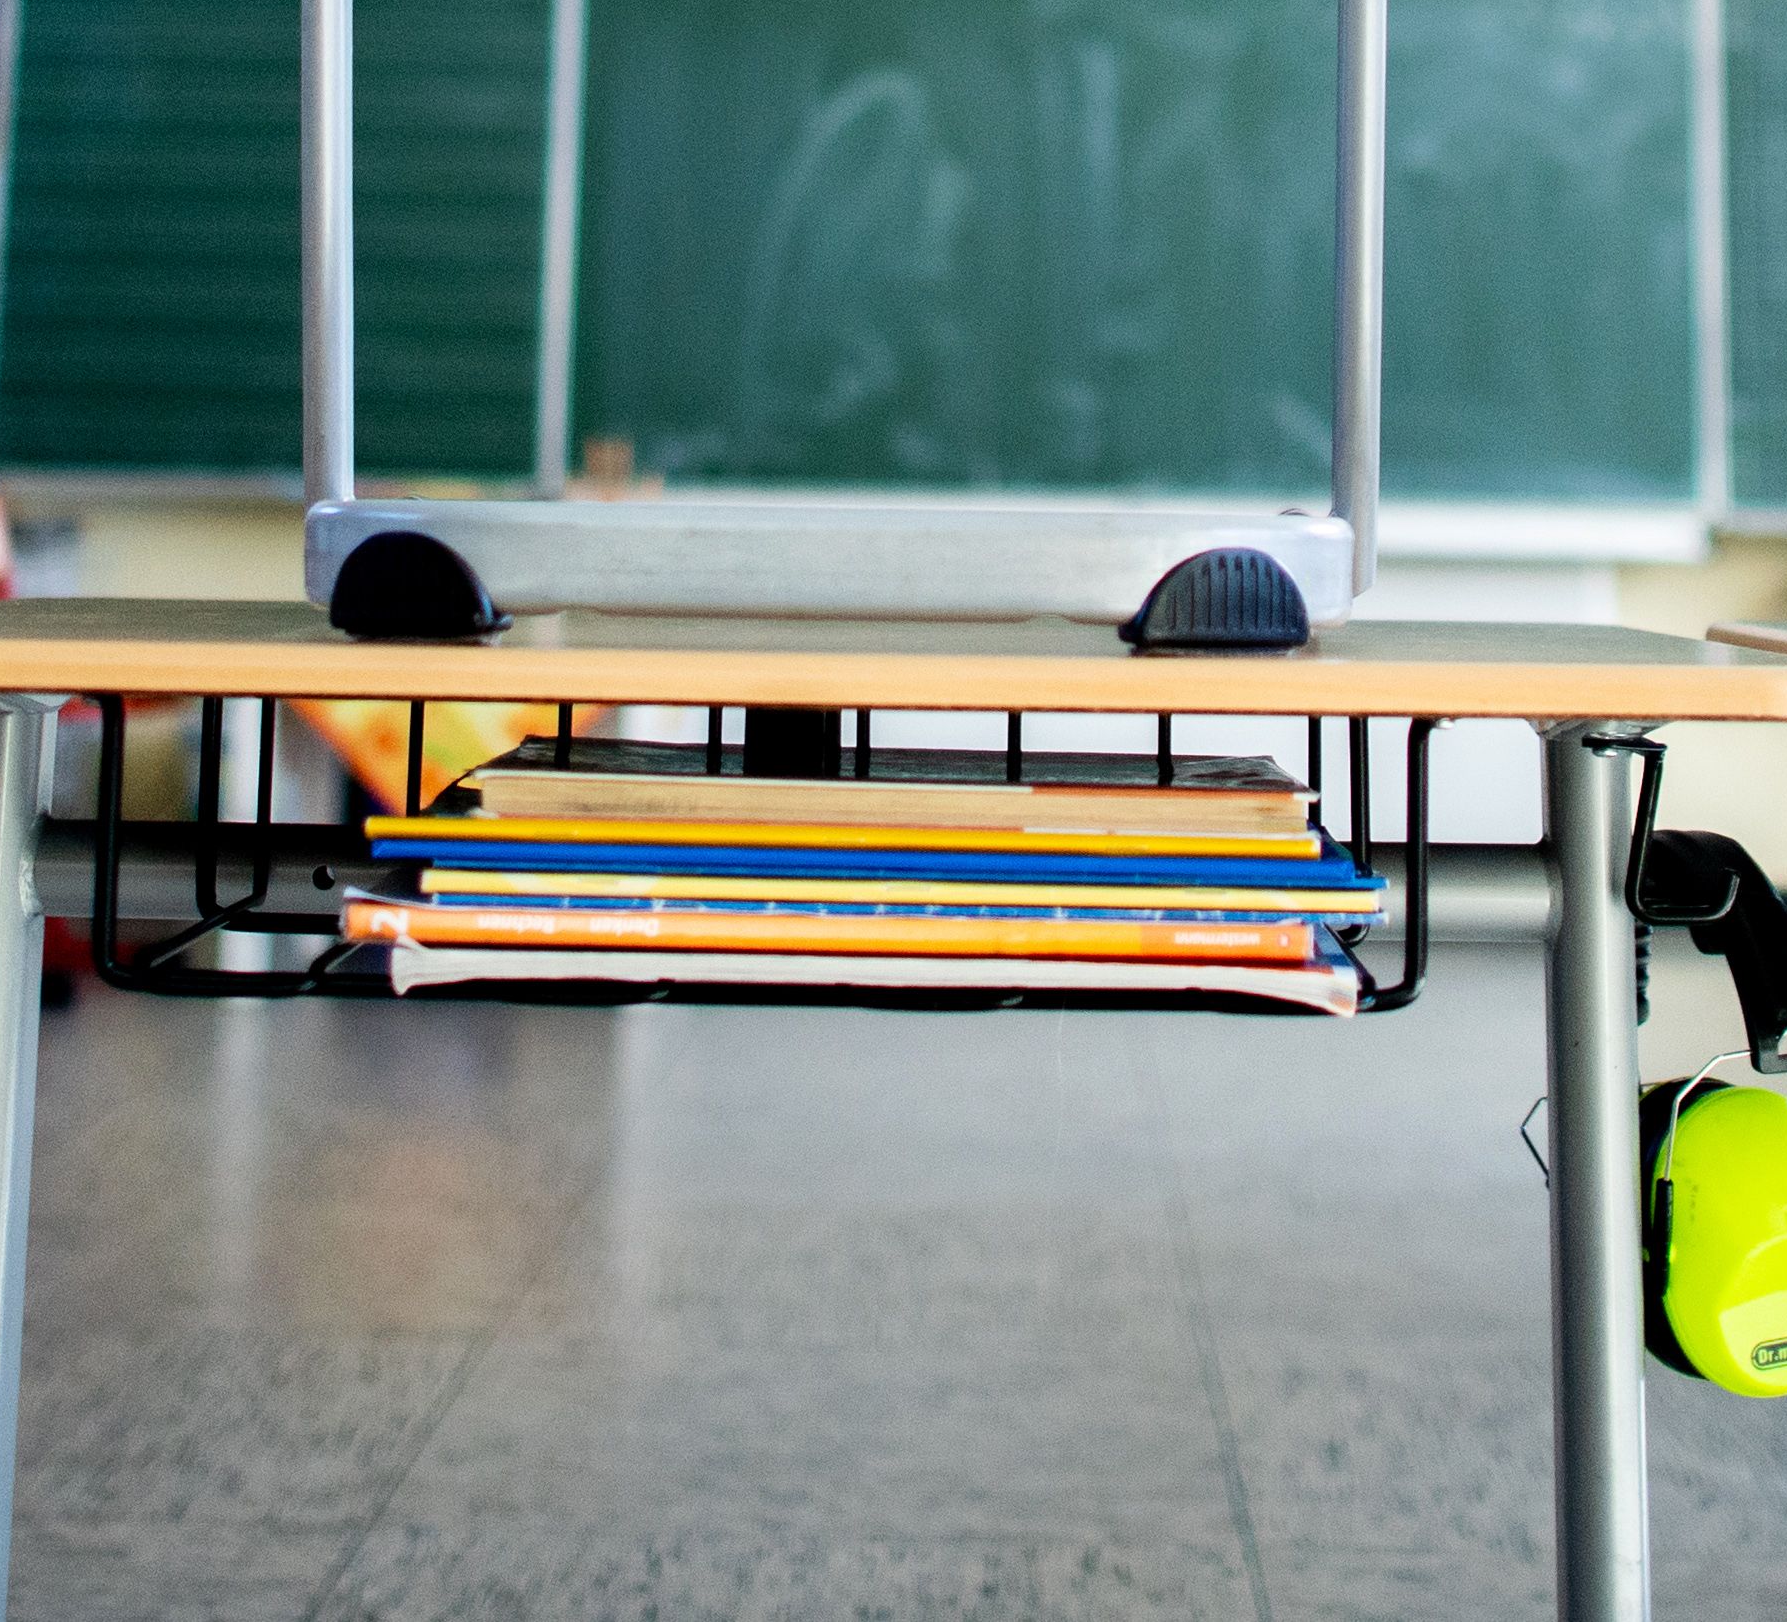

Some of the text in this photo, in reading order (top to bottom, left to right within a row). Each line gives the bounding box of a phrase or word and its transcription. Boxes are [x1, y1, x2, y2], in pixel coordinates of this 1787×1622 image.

[478, 914, 555, 934] Rechnen
[590, 916, 660, 937] Denken
[1174, 931, 1260, 946] westermann
